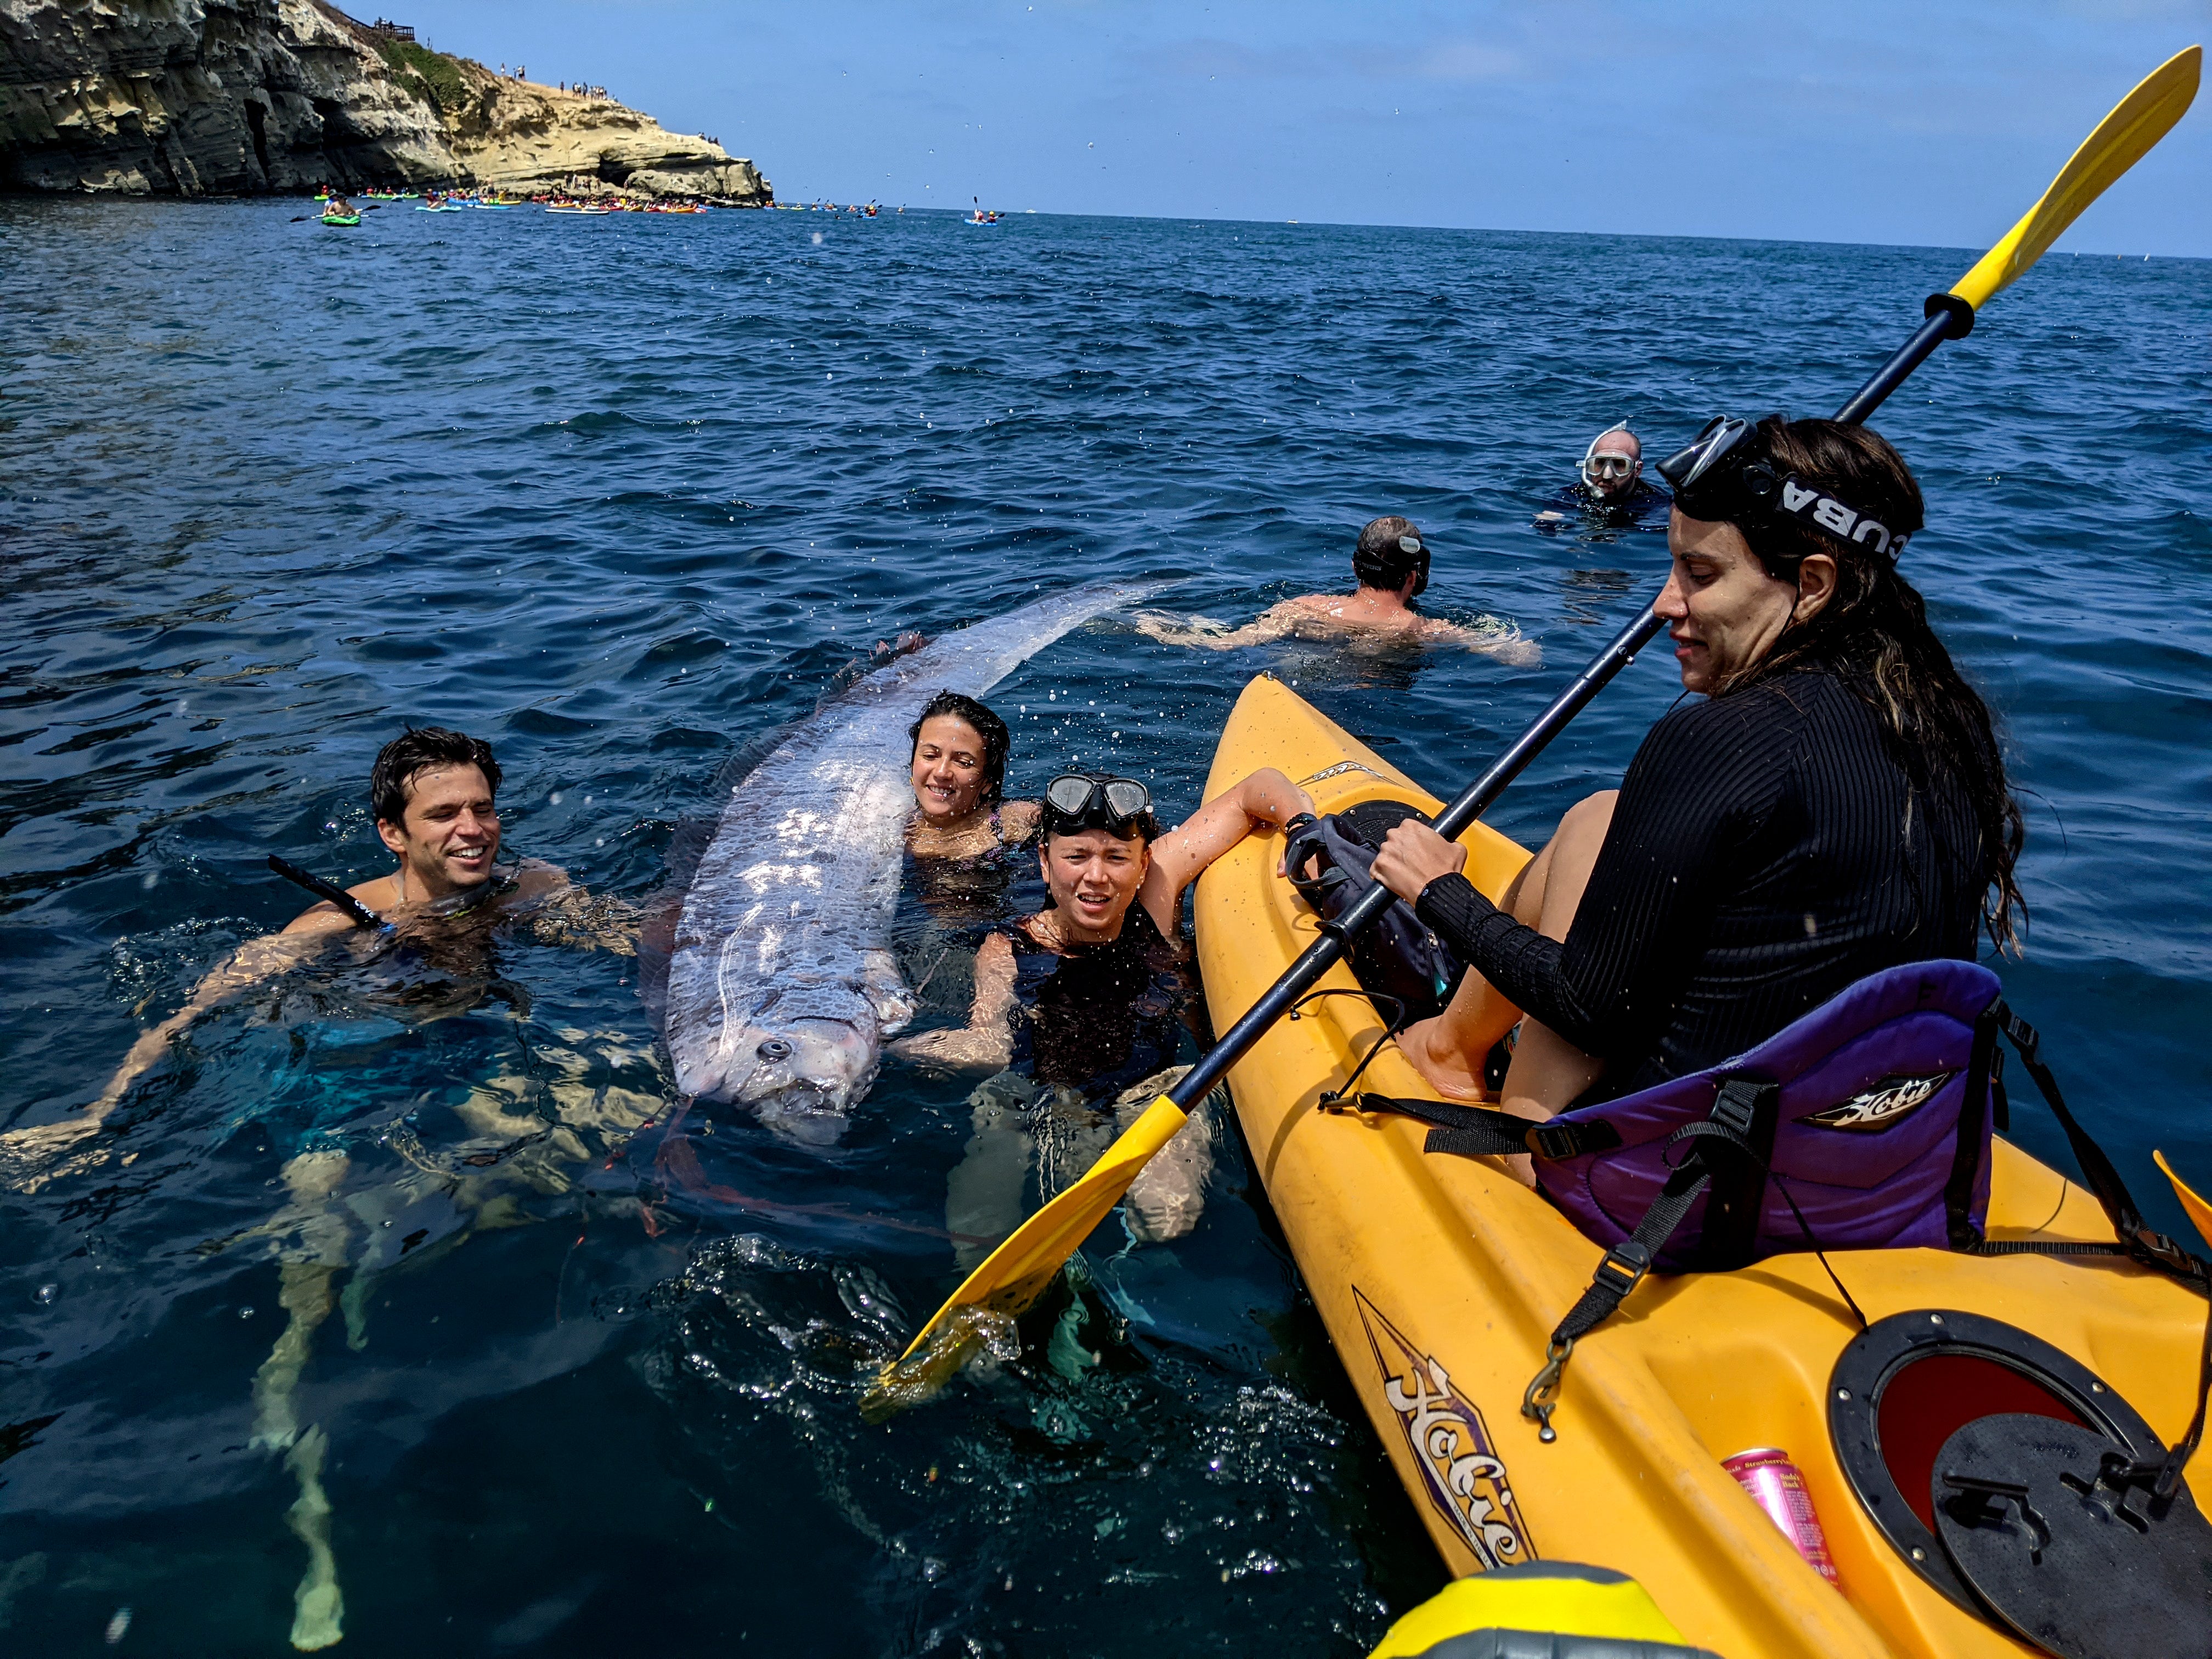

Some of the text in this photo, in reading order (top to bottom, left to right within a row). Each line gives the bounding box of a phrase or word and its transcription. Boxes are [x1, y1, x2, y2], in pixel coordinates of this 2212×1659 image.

[1833, 1080, 1932, 1126] Hobie
[1384, 1355, 1517, 1568] Hobie
[1453, 1505, 1466, 1527] MADE
[1467, 1528, 1474, 1538] IN
[1474, 1538, 1483, 1555] THE
